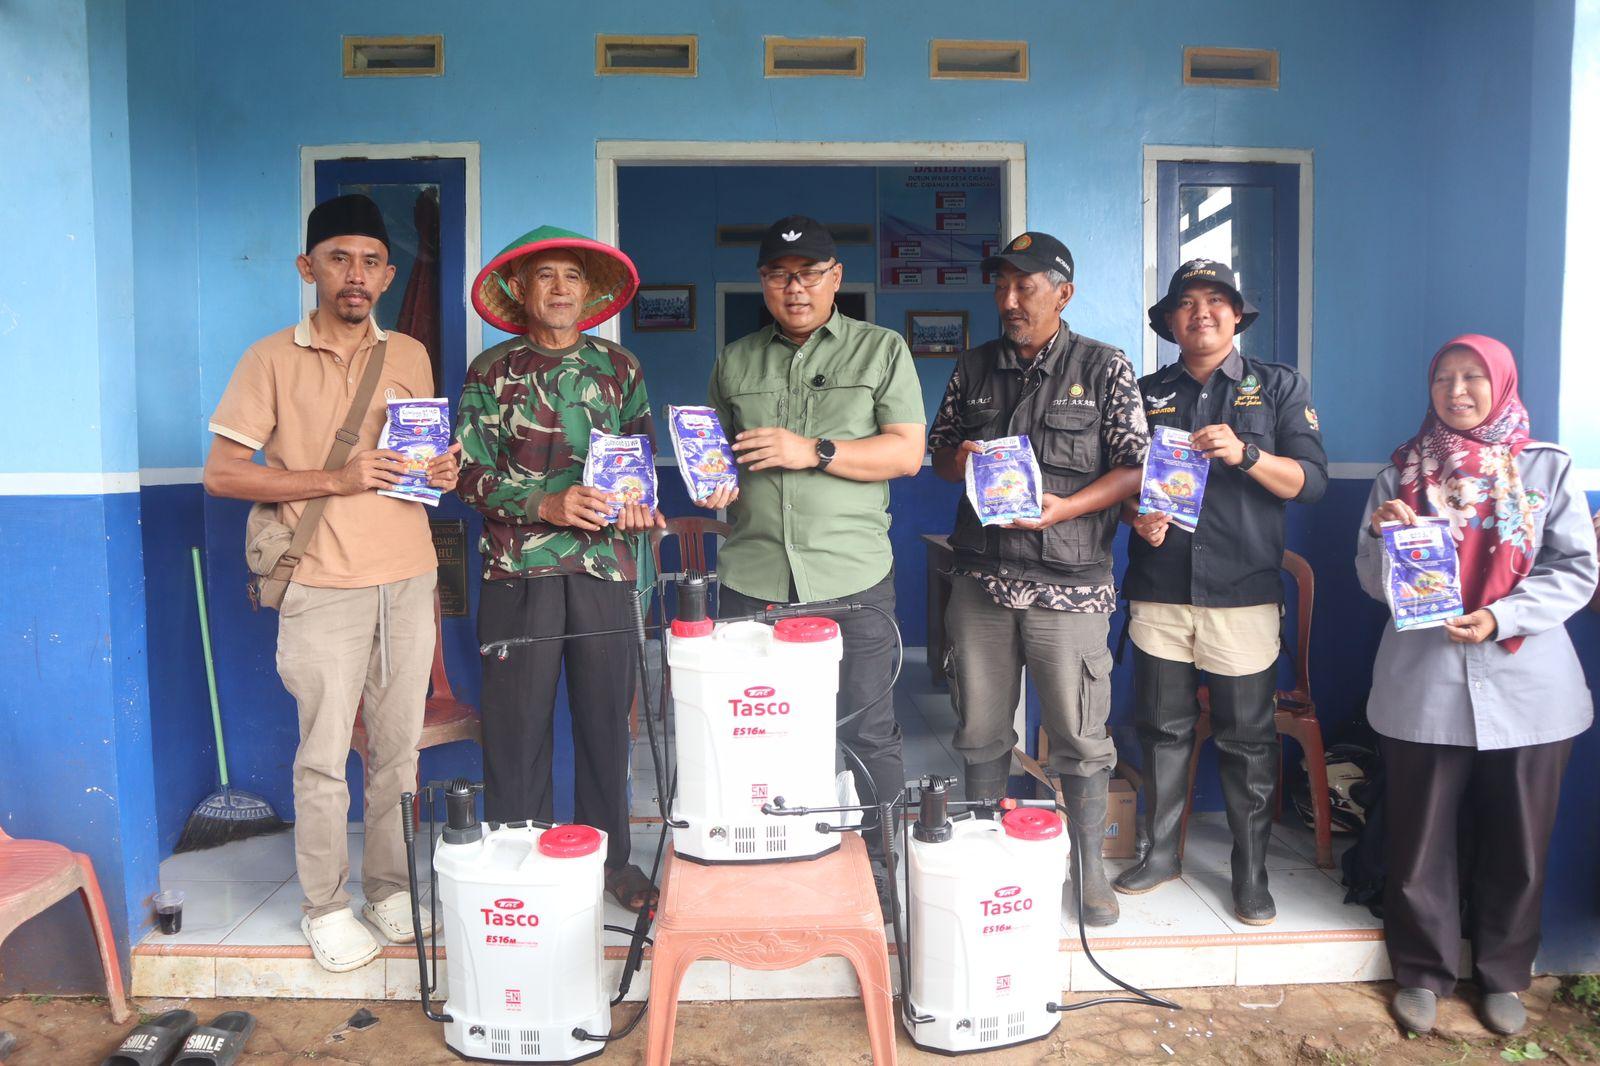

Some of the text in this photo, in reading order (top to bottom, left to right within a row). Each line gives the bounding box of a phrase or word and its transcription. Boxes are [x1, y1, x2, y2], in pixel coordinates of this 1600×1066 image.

[1182, 269, 1216, 279] PREDATOR
[727, 699, 790, 717] Tasco
[979, 898, 1033, 917] Tasco
[480, 908, 539, 927] Tasco
[187, 1035, 225, 1051] SMILE
